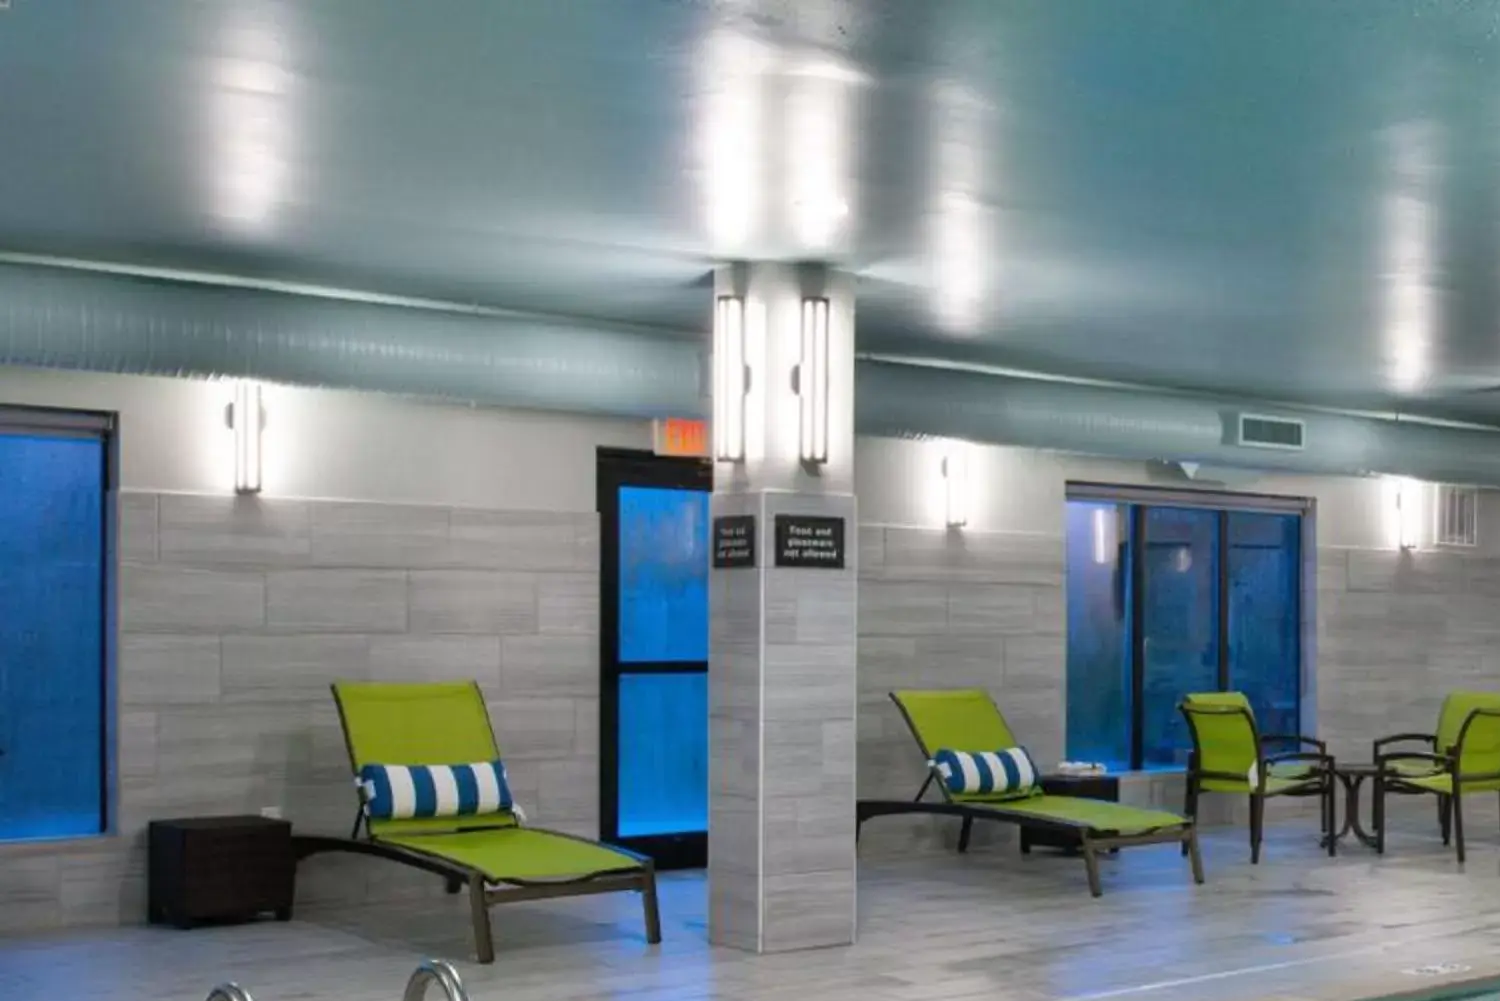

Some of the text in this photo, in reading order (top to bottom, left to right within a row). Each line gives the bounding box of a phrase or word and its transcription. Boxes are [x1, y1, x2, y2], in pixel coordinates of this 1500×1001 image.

[815, 527, 832, 537] and
[783, 549, 837, 560] not allowed
